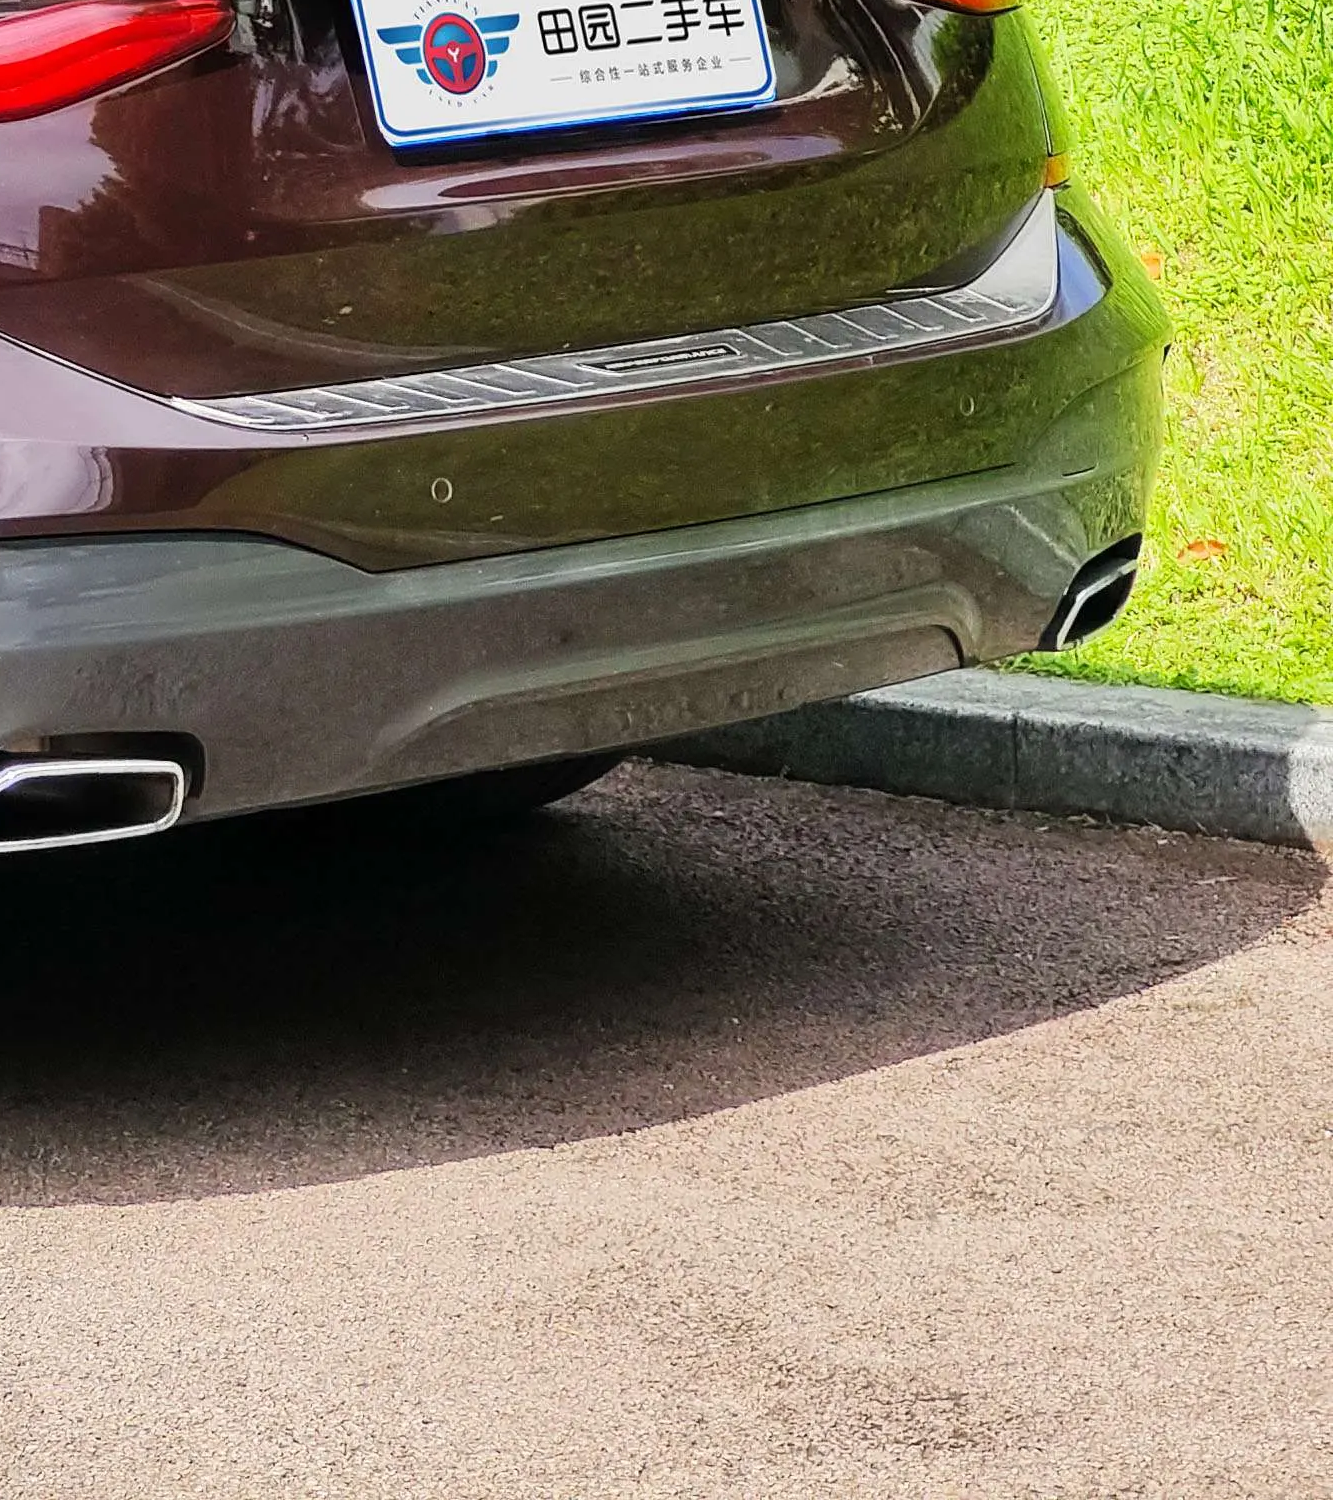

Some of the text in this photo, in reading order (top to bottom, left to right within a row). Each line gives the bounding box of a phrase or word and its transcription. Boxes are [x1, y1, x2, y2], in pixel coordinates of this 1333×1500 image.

[579, 56, 723, 84] 综合性一站式服务企业
